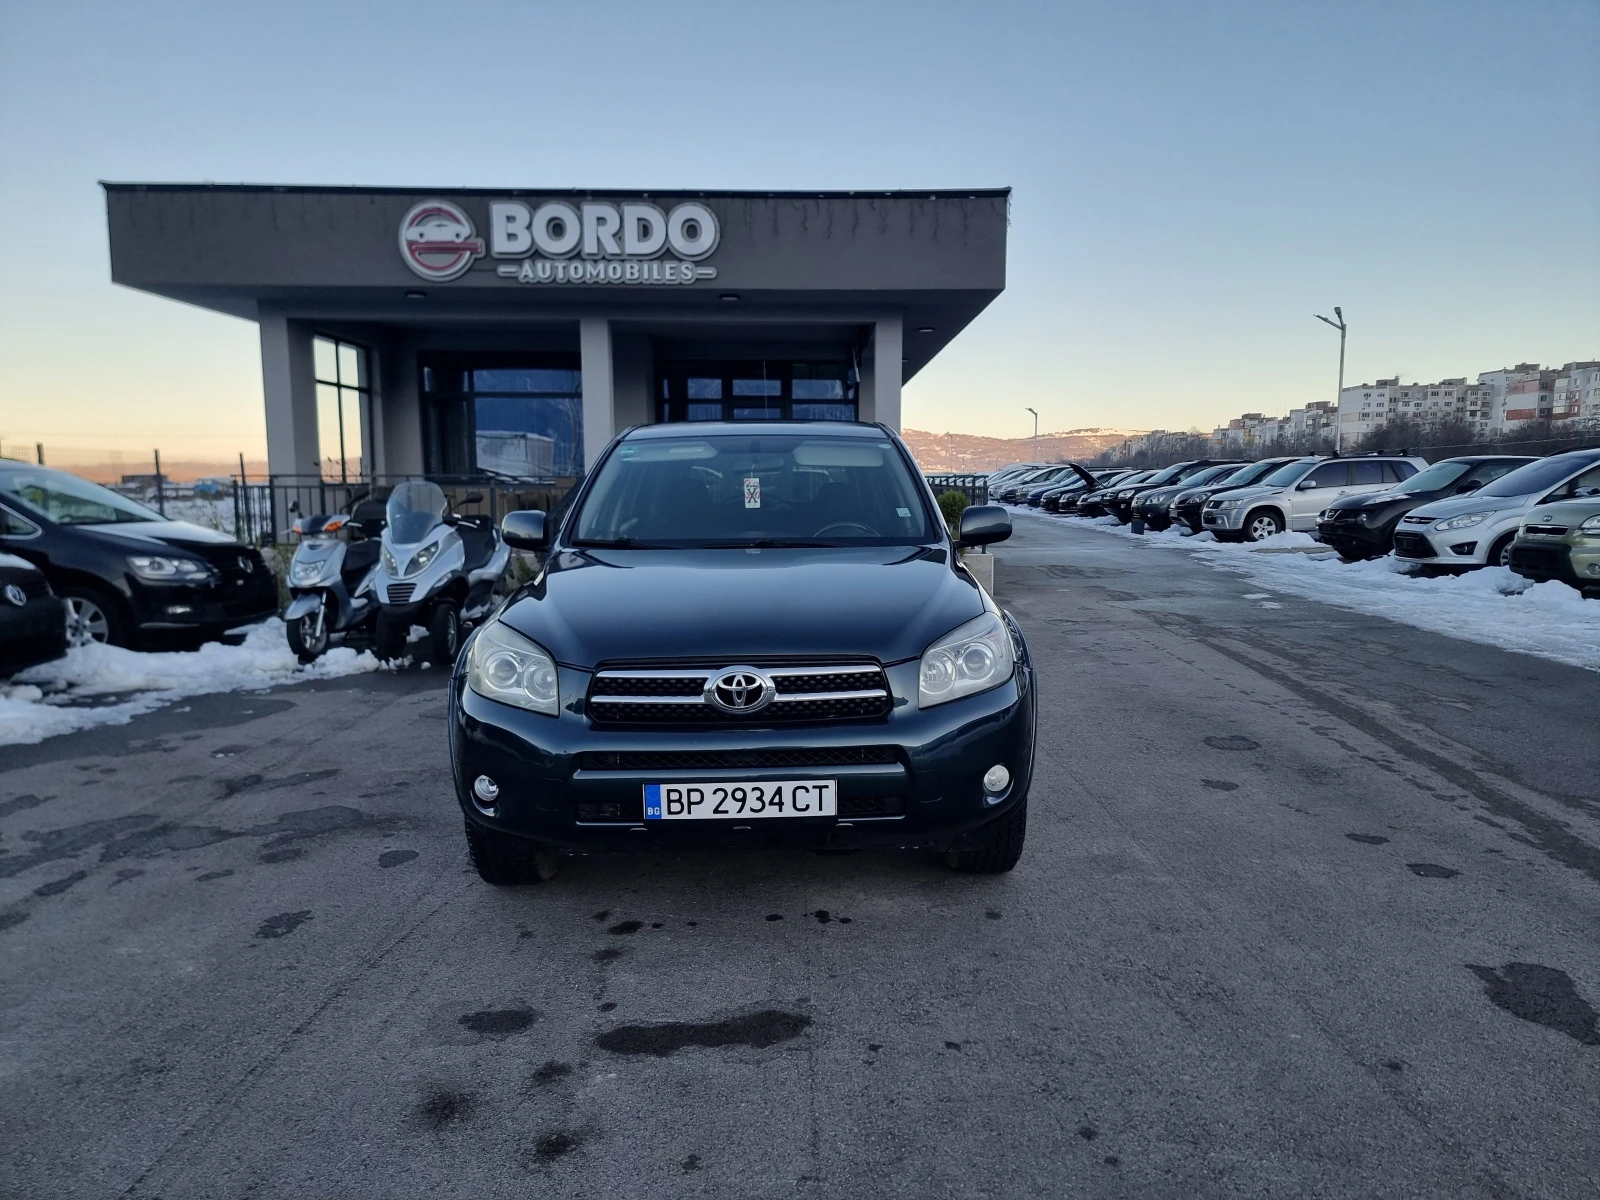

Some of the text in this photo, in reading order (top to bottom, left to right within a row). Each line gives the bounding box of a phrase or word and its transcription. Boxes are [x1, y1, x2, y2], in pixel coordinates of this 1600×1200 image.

[491, 202, 717, 257] BORDO
[519, 261, 694, 281] AUTOMOBILES
[647, 807, 660, 815] BG
[666, 785, 830, 815] BP 2934 CT
